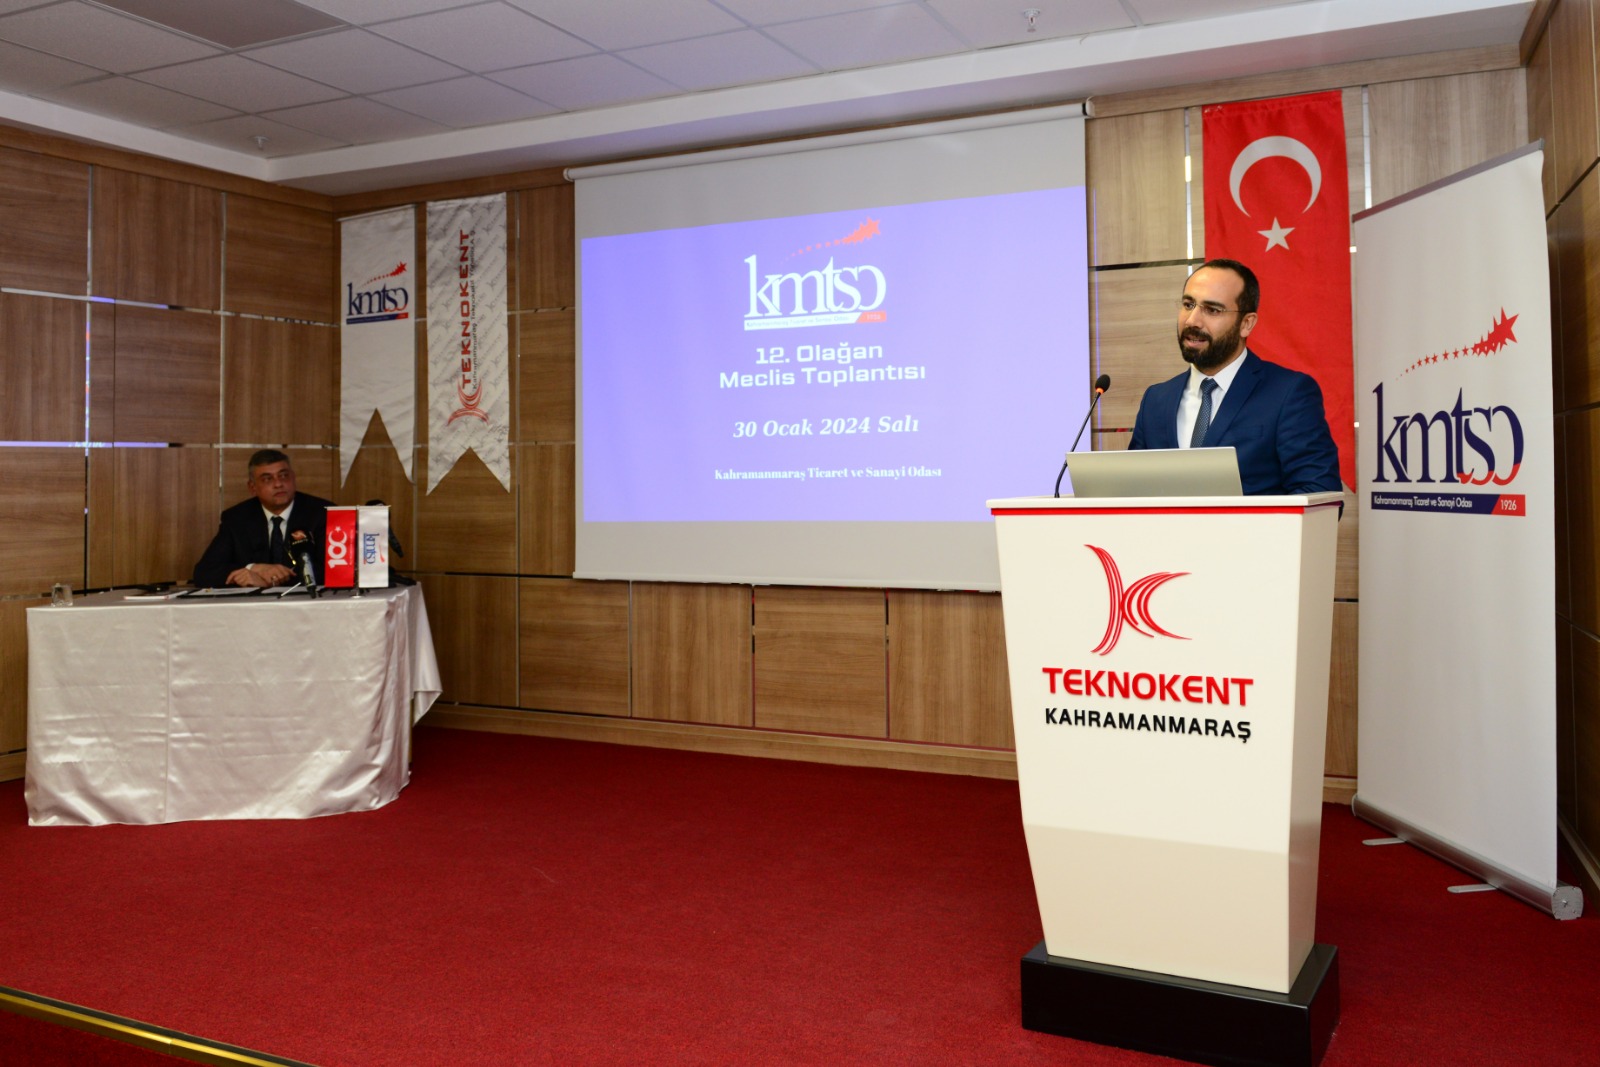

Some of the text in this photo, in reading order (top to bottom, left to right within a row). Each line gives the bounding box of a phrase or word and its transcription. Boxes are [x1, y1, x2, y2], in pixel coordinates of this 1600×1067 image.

[460, 229, 471, 389] TEKNOKENT
[756, 342, 882, 364] 12. Olağan
[720, 365, 925, 388] Meclis Toplantısı
[733, 415, 919, 437] 30 Ocak 2024 Salı
[715, 466, 941, 481] Kahramanmaraş Ticaret ve Sanayi Odası
[1374, 495, 1413, 508] Kahramanmaraş
[1413, 496, 1429, 506] Ticaret
[1437, 497, 1455, 509] Sanayi
[1457, 498, 1472, 507] Odası
[1501, 500, 1517, 510] 1926
[1042, 667, 1254, 706] TEKNOKENT
[1045, 707, 1251, 743] KAHRAMANMARAŞ
